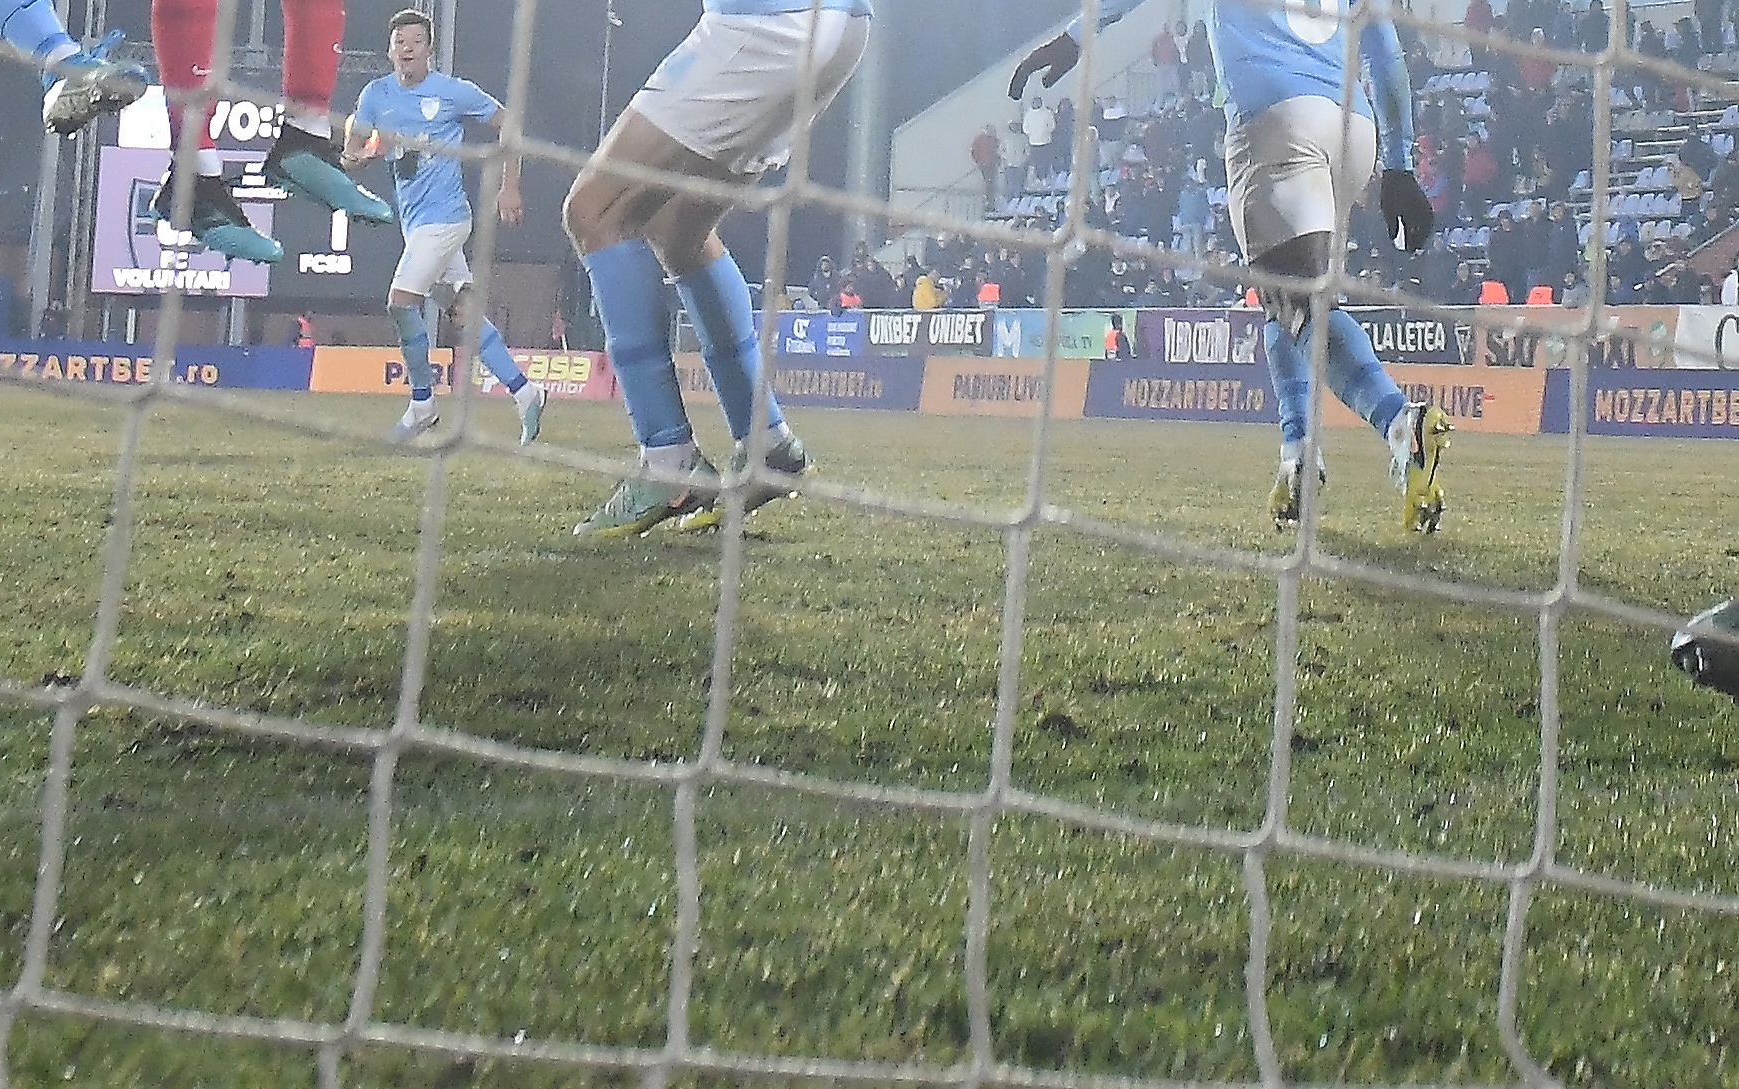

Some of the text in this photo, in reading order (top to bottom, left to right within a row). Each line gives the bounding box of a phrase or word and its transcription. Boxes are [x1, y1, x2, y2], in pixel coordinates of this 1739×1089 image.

[112, 268, 232, 291] VOLUNTARI
[869, 314, 922, 345] UNIBET
[928, 314, 986, 345] UNIBET
[1396, 320, 1445, 352] LETEA
[1123, 378, 1265, 411] MOZZARTBET.ro
